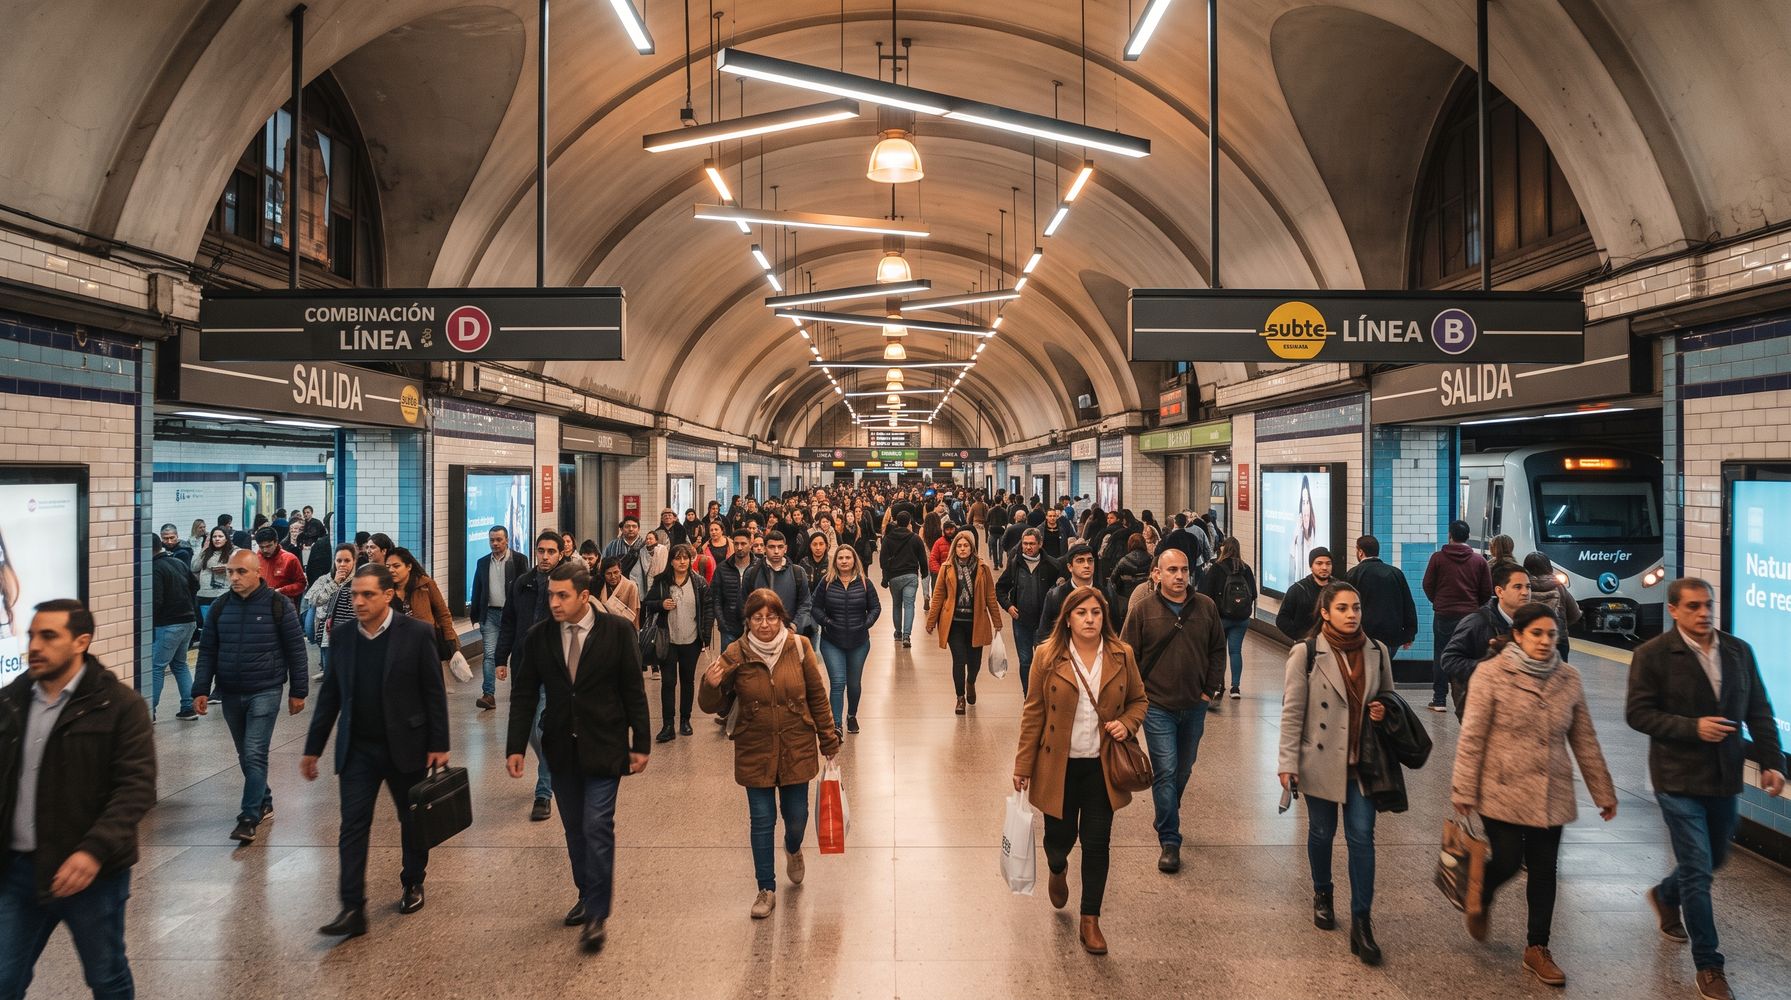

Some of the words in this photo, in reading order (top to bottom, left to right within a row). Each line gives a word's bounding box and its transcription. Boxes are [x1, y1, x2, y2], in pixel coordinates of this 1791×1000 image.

[304, 302, 435, 323] COMBINACIÓN
[340, 325, 412, 350] LÍNEA
[458, 316, 481, 342] D
[1267, 318, 1325, 337] subte
[1343, 314, 1424, 343] LÍNEA
[1444, 318, 1465, 344] B
[292, 363, 363, 412] SALIDA
[1440, 363, 1513, 407] SALIDA
[1578, 549, 1632, 564] Materfer
[1745, 582, 1767, 609] de
